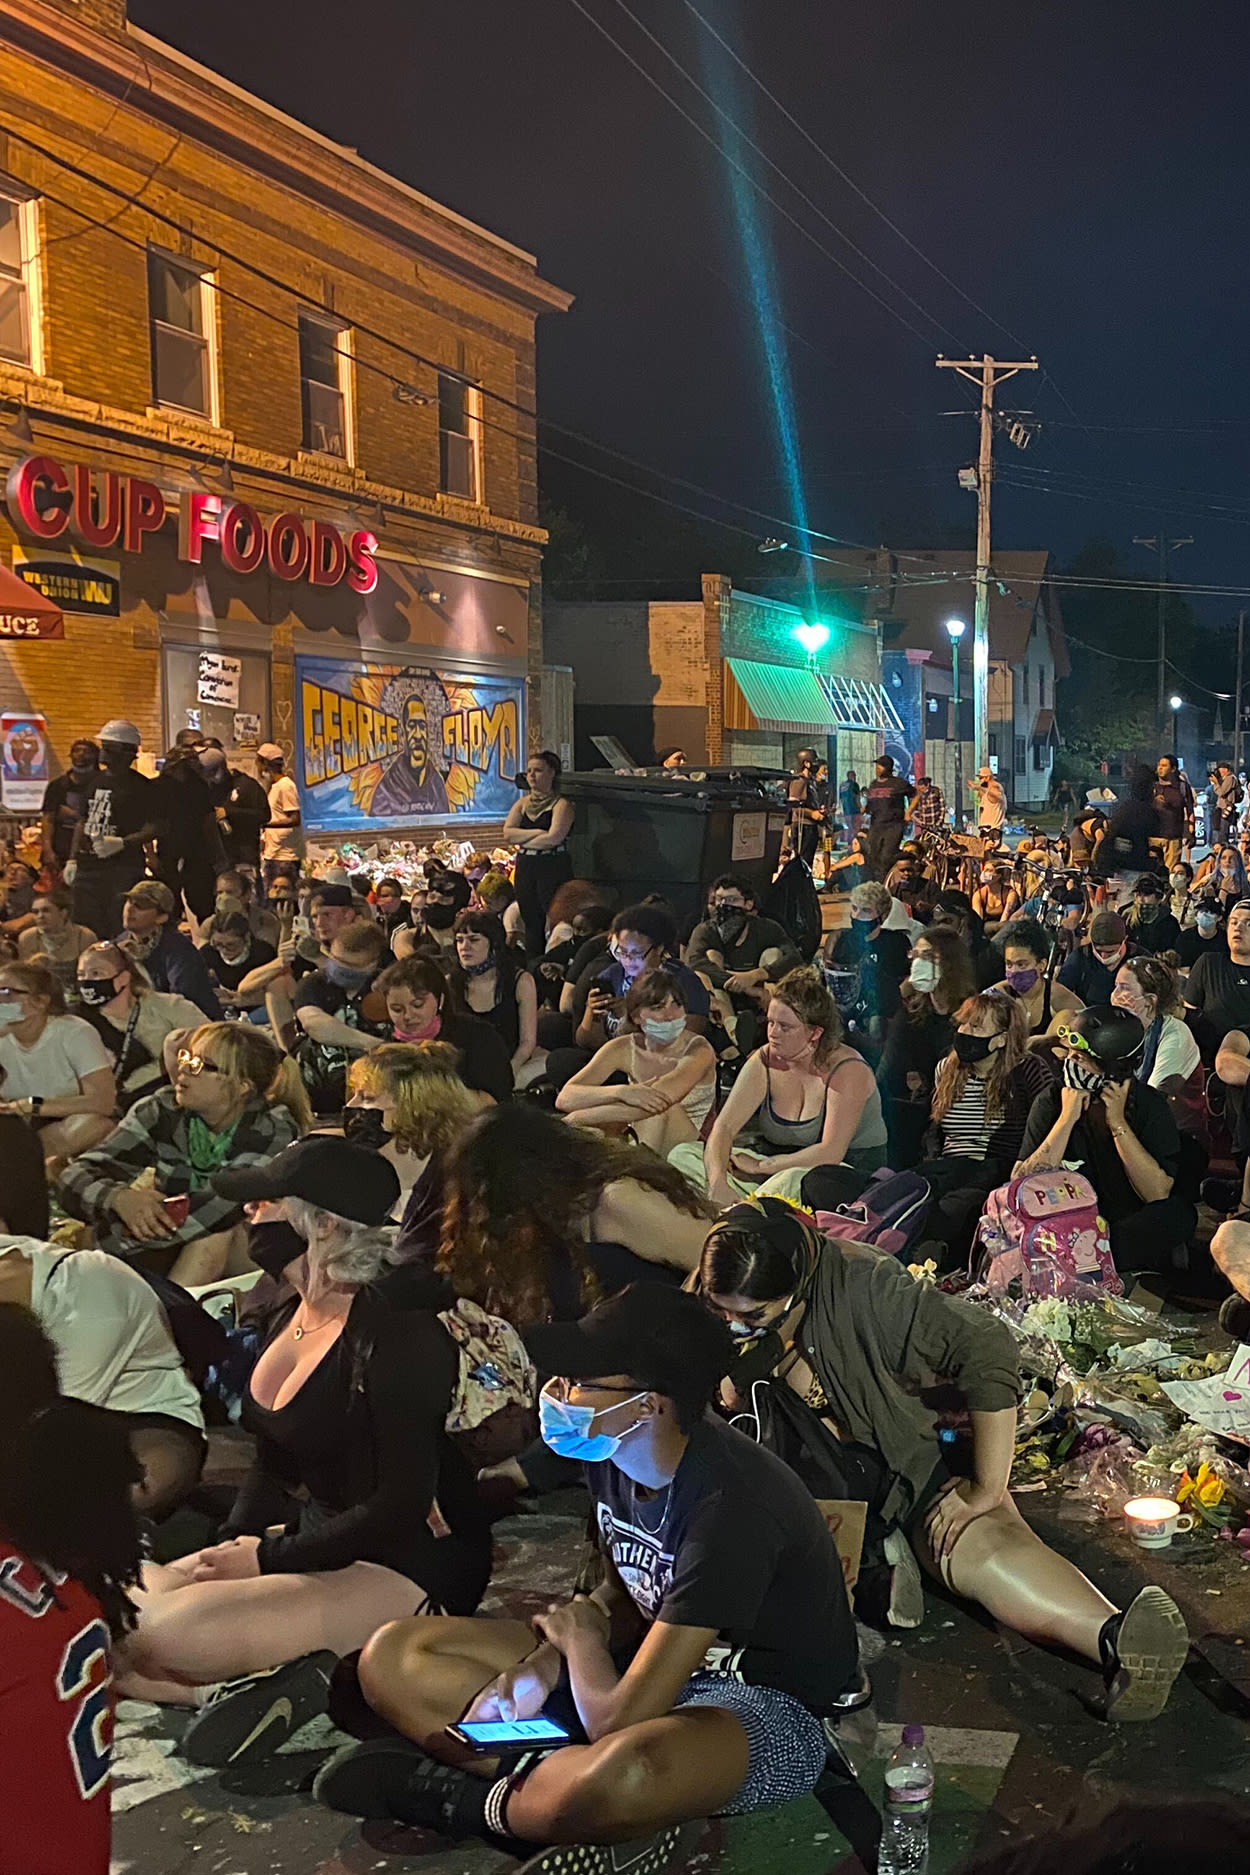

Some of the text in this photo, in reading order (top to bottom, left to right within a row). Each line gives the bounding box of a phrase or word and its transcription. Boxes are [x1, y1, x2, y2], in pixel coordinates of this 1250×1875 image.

[12, 456, 379, 595] CUP FOODS
[23, 571, 78, 588] WESTERN
[41, 585, 78, 600] UNION
[302, 680, 517, 788] GEORGE FLOYD
